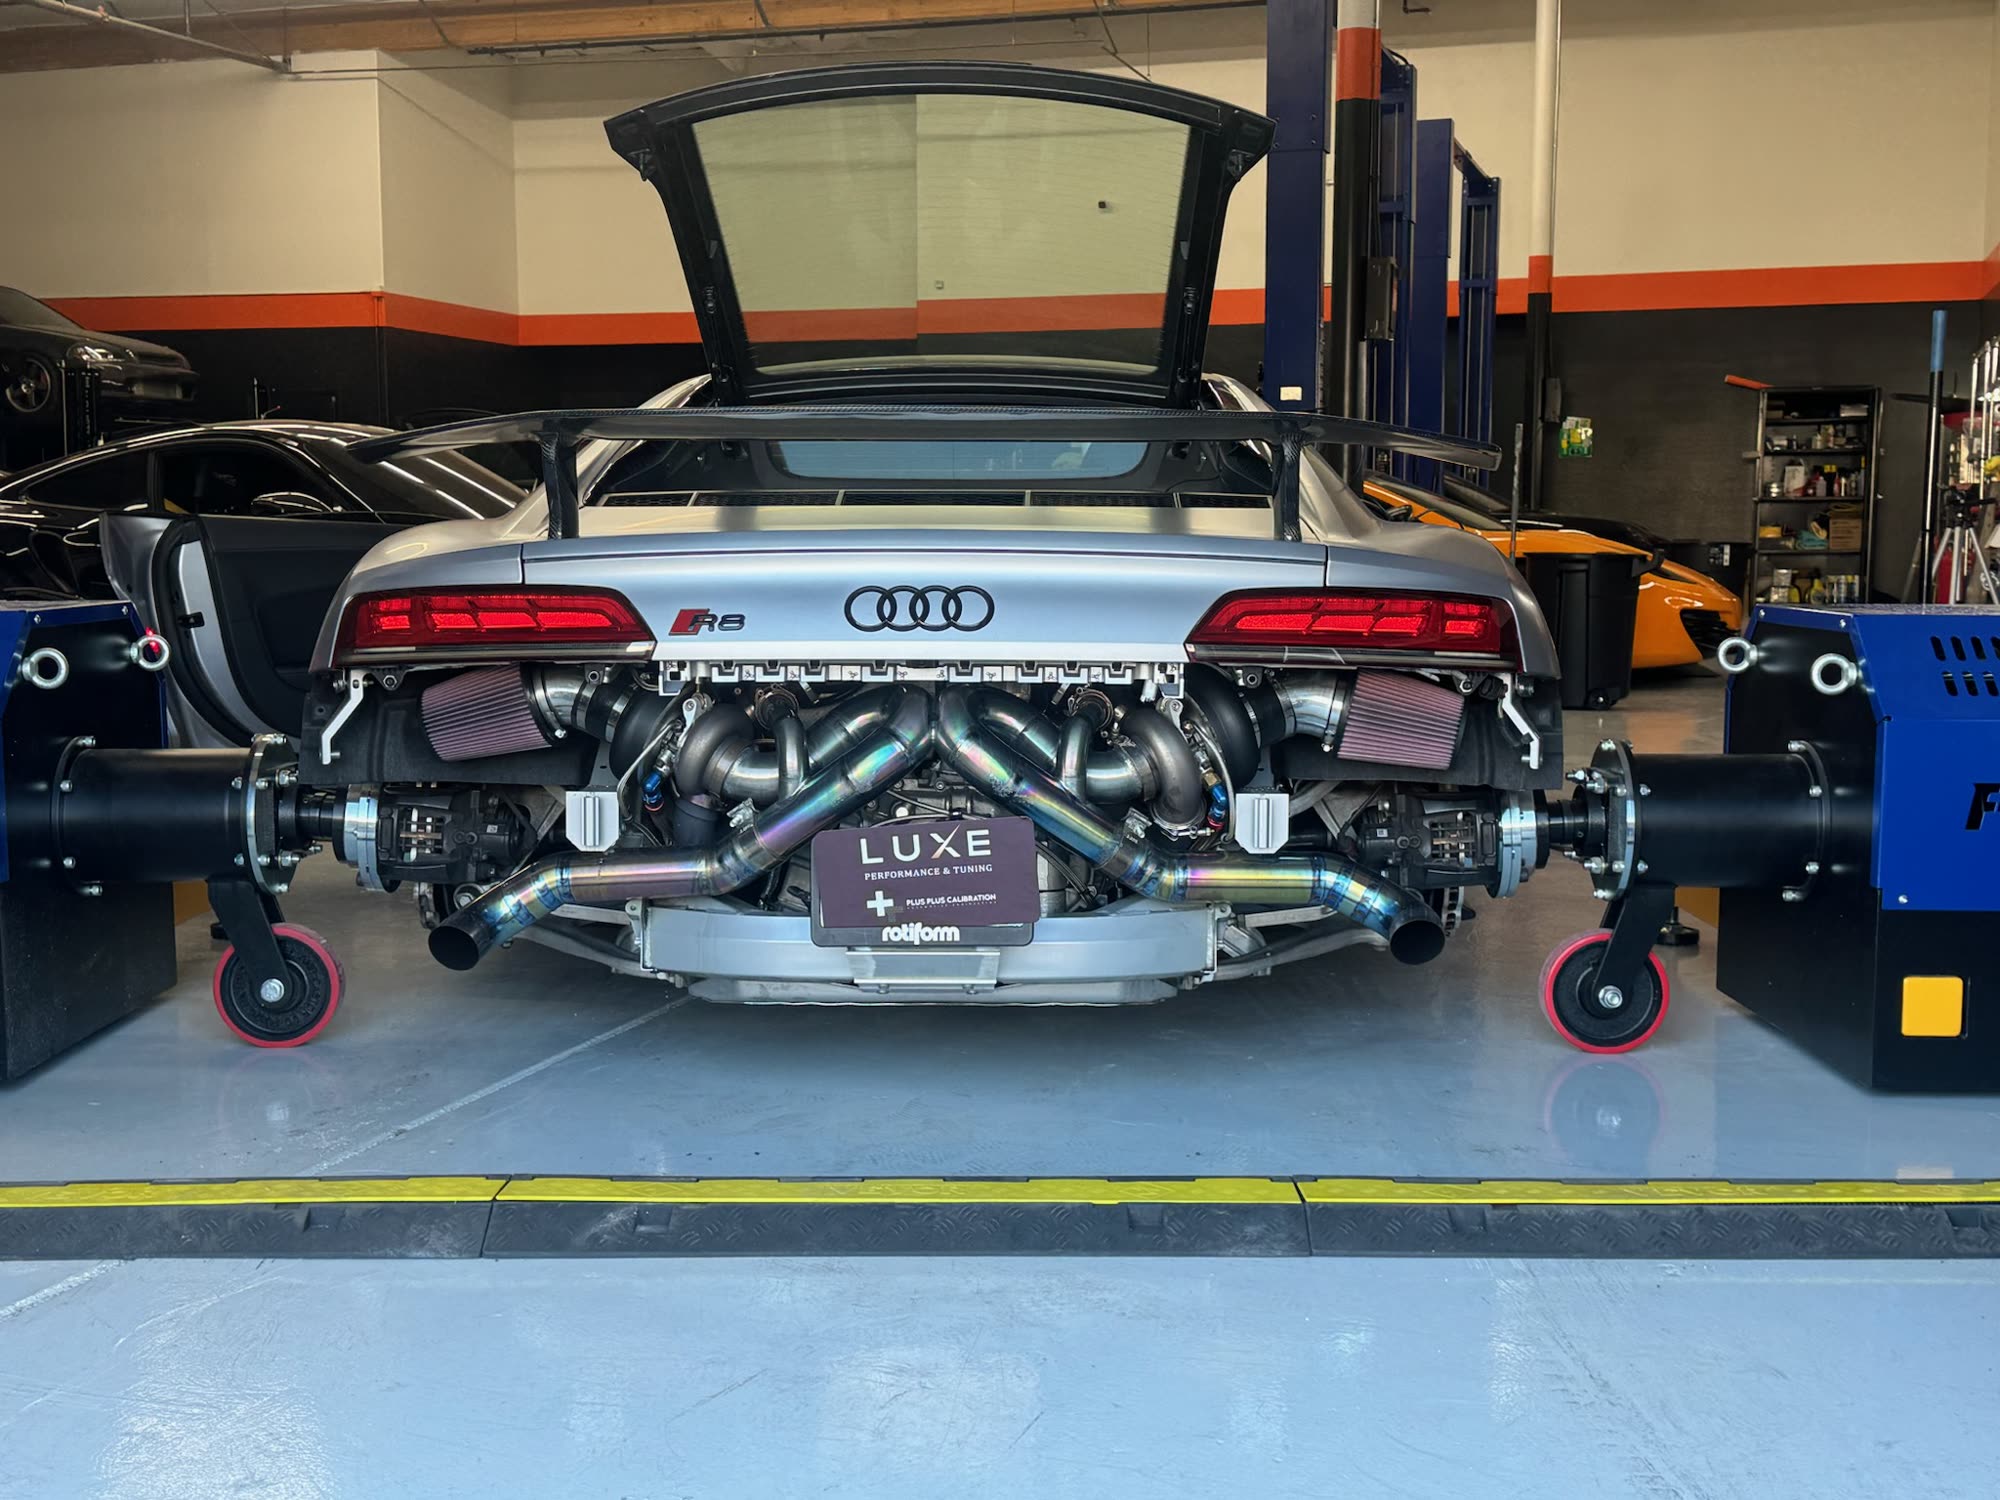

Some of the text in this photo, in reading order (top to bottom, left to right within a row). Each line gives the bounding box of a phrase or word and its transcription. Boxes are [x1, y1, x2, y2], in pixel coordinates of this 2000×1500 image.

[1965, 783, 2000, 831] F
[860, 824, 991, 865] LUXE
[864, 864, 993, 881] PERFORMANCE & TUNING
[906, 898, 926, 907] PLUS
[926, 896, 946, 905] PLUS
[946, 893, 997, 904] CALIBRATION
[882, 921, 960, 946] rotiform
